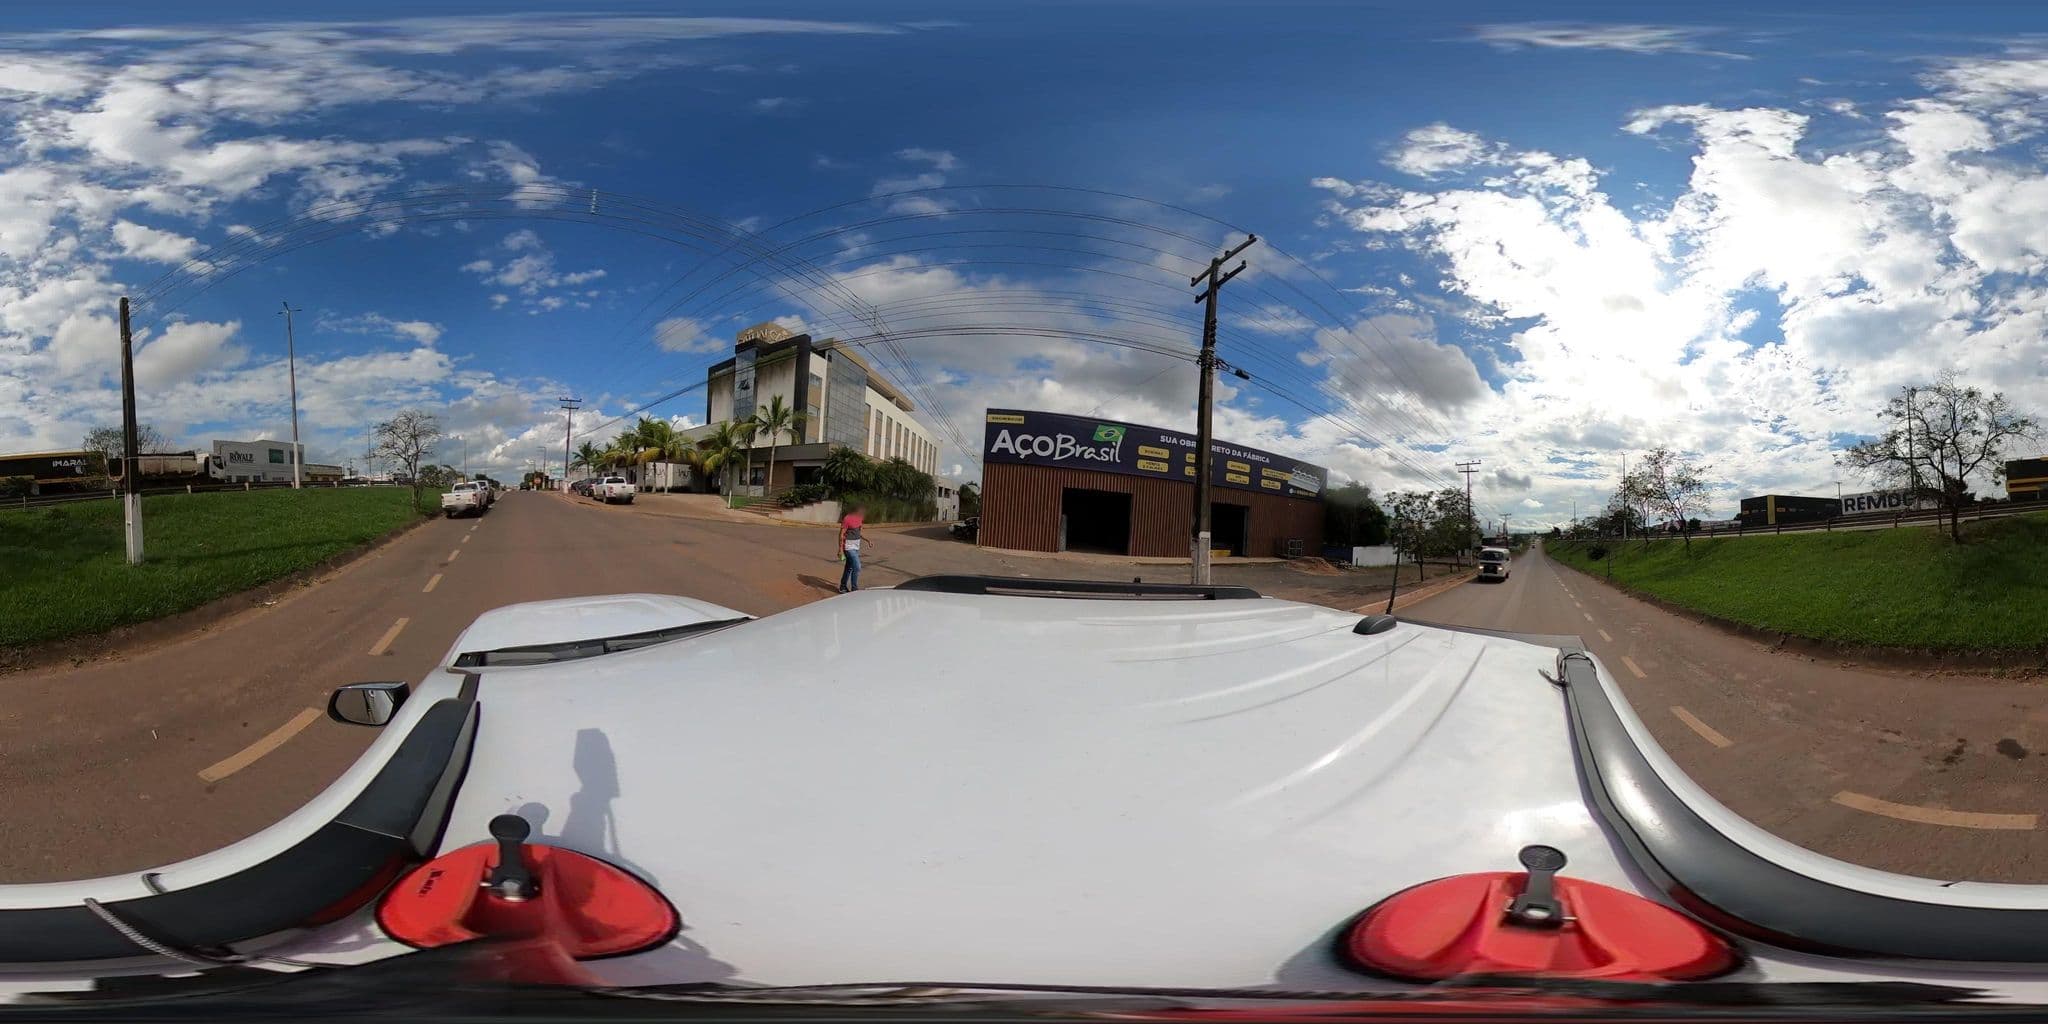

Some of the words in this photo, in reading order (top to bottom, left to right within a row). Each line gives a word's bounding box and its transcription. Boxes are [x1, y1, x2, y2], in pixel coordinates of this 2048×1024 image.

[1160, 435, 1178, 445] SUA
[1179, 439, 1197, 449] OBR
[1211, 445, 1231, 455] RETO
[1231, 450, 1242, 458] DA
[1242, 450, 1270, 463] FÁBRICA
